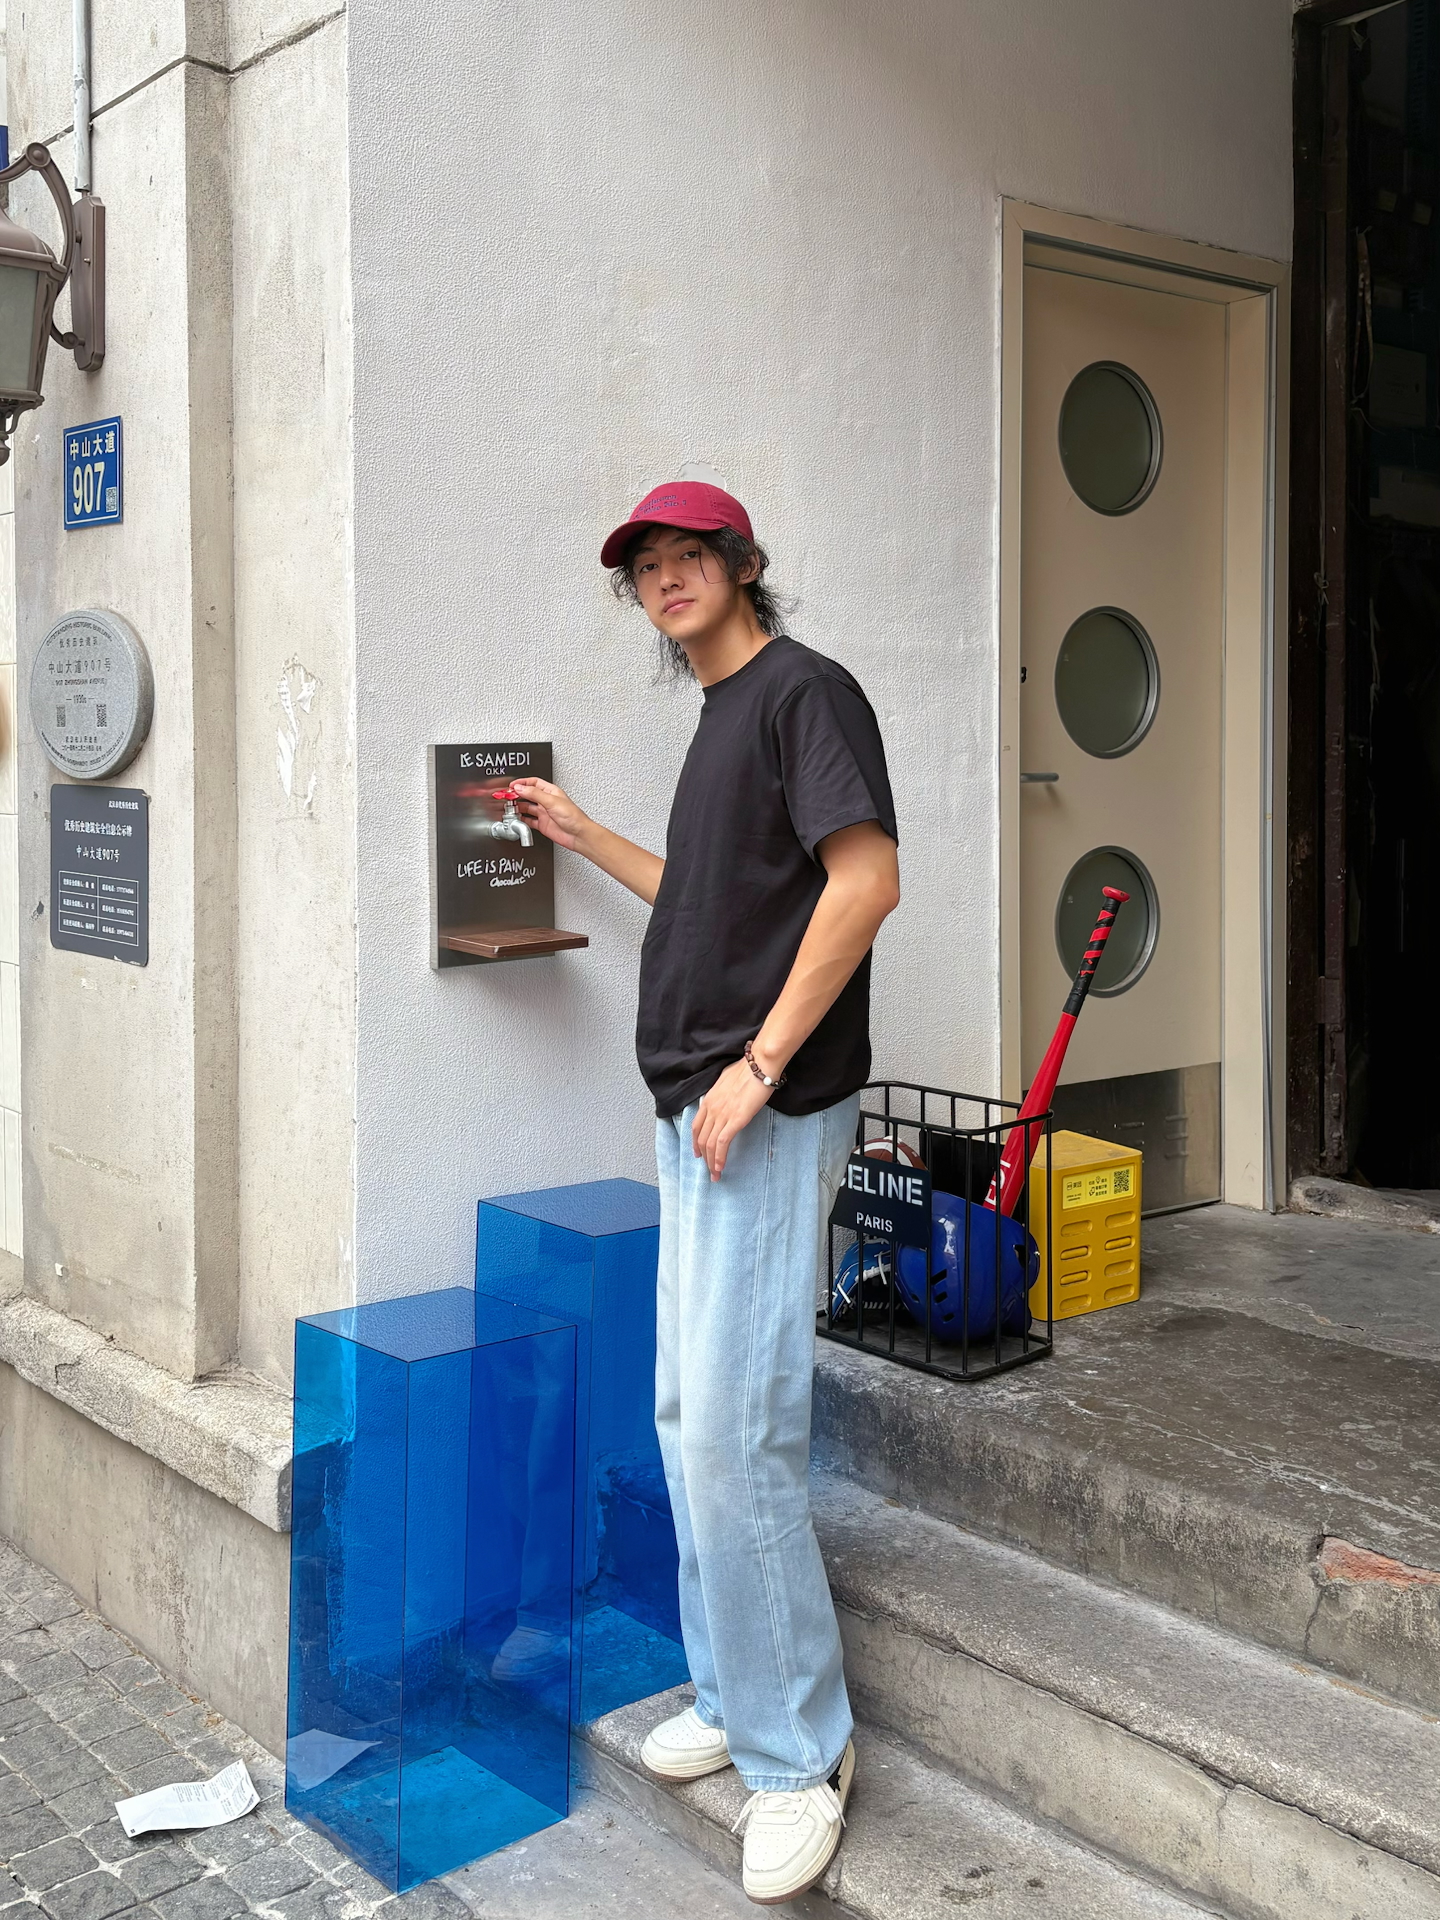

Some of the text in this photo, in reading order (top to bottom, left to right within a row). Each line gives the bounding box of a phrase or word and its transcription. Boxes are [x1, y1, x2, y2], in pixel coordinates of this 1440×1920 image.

[69, 430, 116, 461] 中山大道
[72, 461, 105, 516] 907
[460, 751, 530, 768] LE SAMEDI
[76, 844, 120, 863] 中山大道907号
[457, 859, 483, 878] LIFE
[840, 1163, 923, 1206] ELINE
[856, 1211, 893, 1233] PARIS
